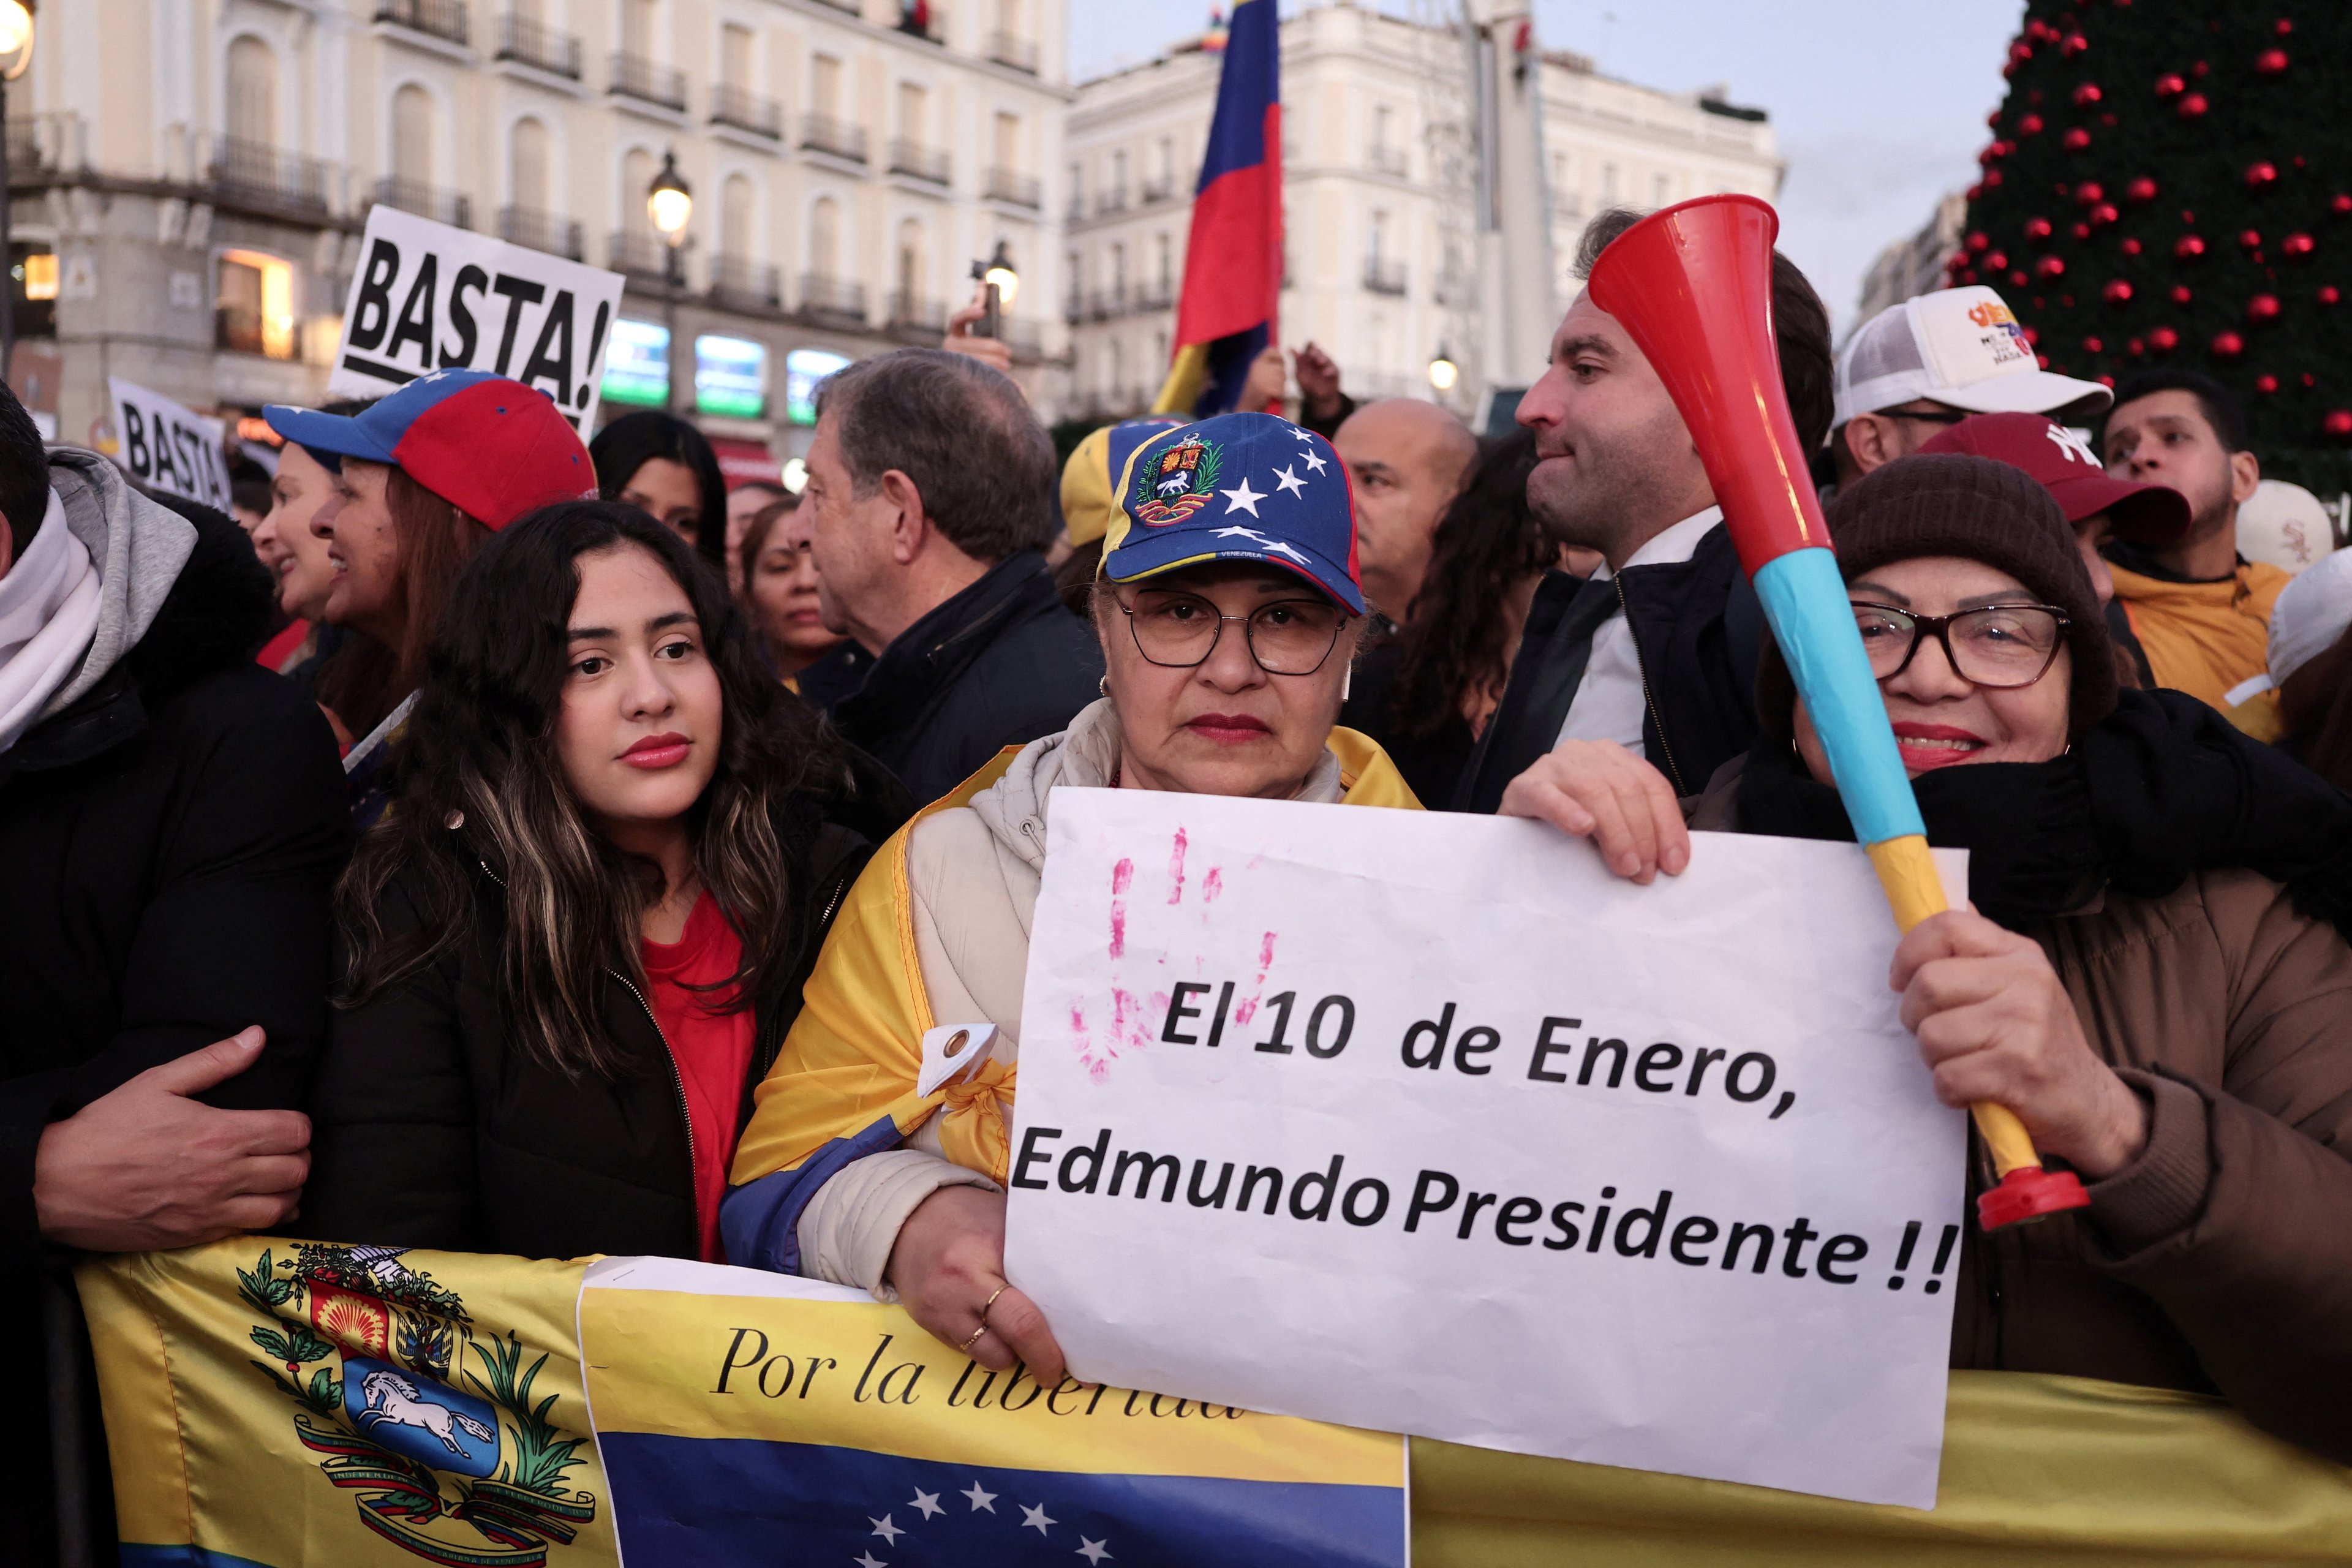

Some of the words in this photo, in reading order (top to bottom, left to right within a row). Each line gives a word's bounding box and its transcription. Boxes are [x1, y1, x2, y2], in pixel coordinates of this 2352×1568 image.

[349, 238, 610, 410] BASTA!
[1162, 981, 1235, 1047] El
[1254, 991, 1355, 1058] 10
[1401, 1002, 1501, 1076] de
[1528, 1016, 1796, 1119] Enero,
[1011, 1127, 1390, 1227] Edmundo
[1404, 1170, 1869, 1284] Presidente
[709, 1328, 837, 1400] Por
[854, 1333, 926, 1406] la
